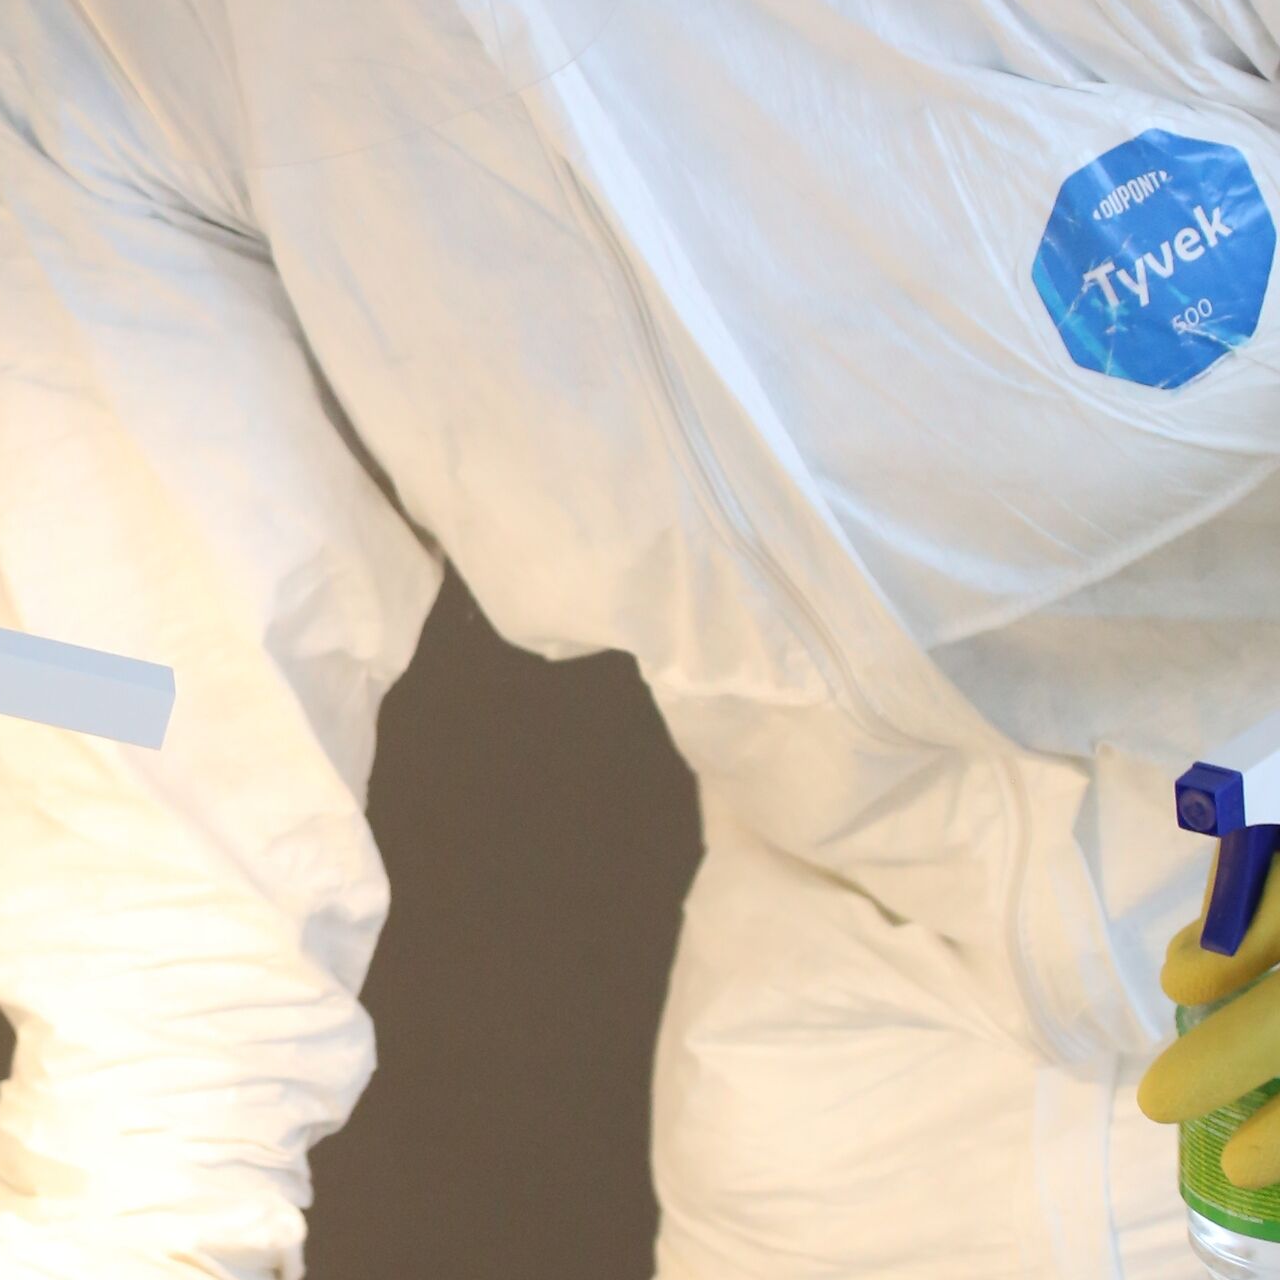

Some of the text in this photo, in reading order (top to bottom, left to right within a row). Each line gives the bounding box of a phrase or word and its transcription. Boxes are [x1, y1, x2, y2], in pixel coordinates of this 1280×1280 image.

[1098, 172, 1161, 220] DUPONT
[1083, 205, 1233, 308] Tyvek
[1172, 298, 1213, 334] 500
